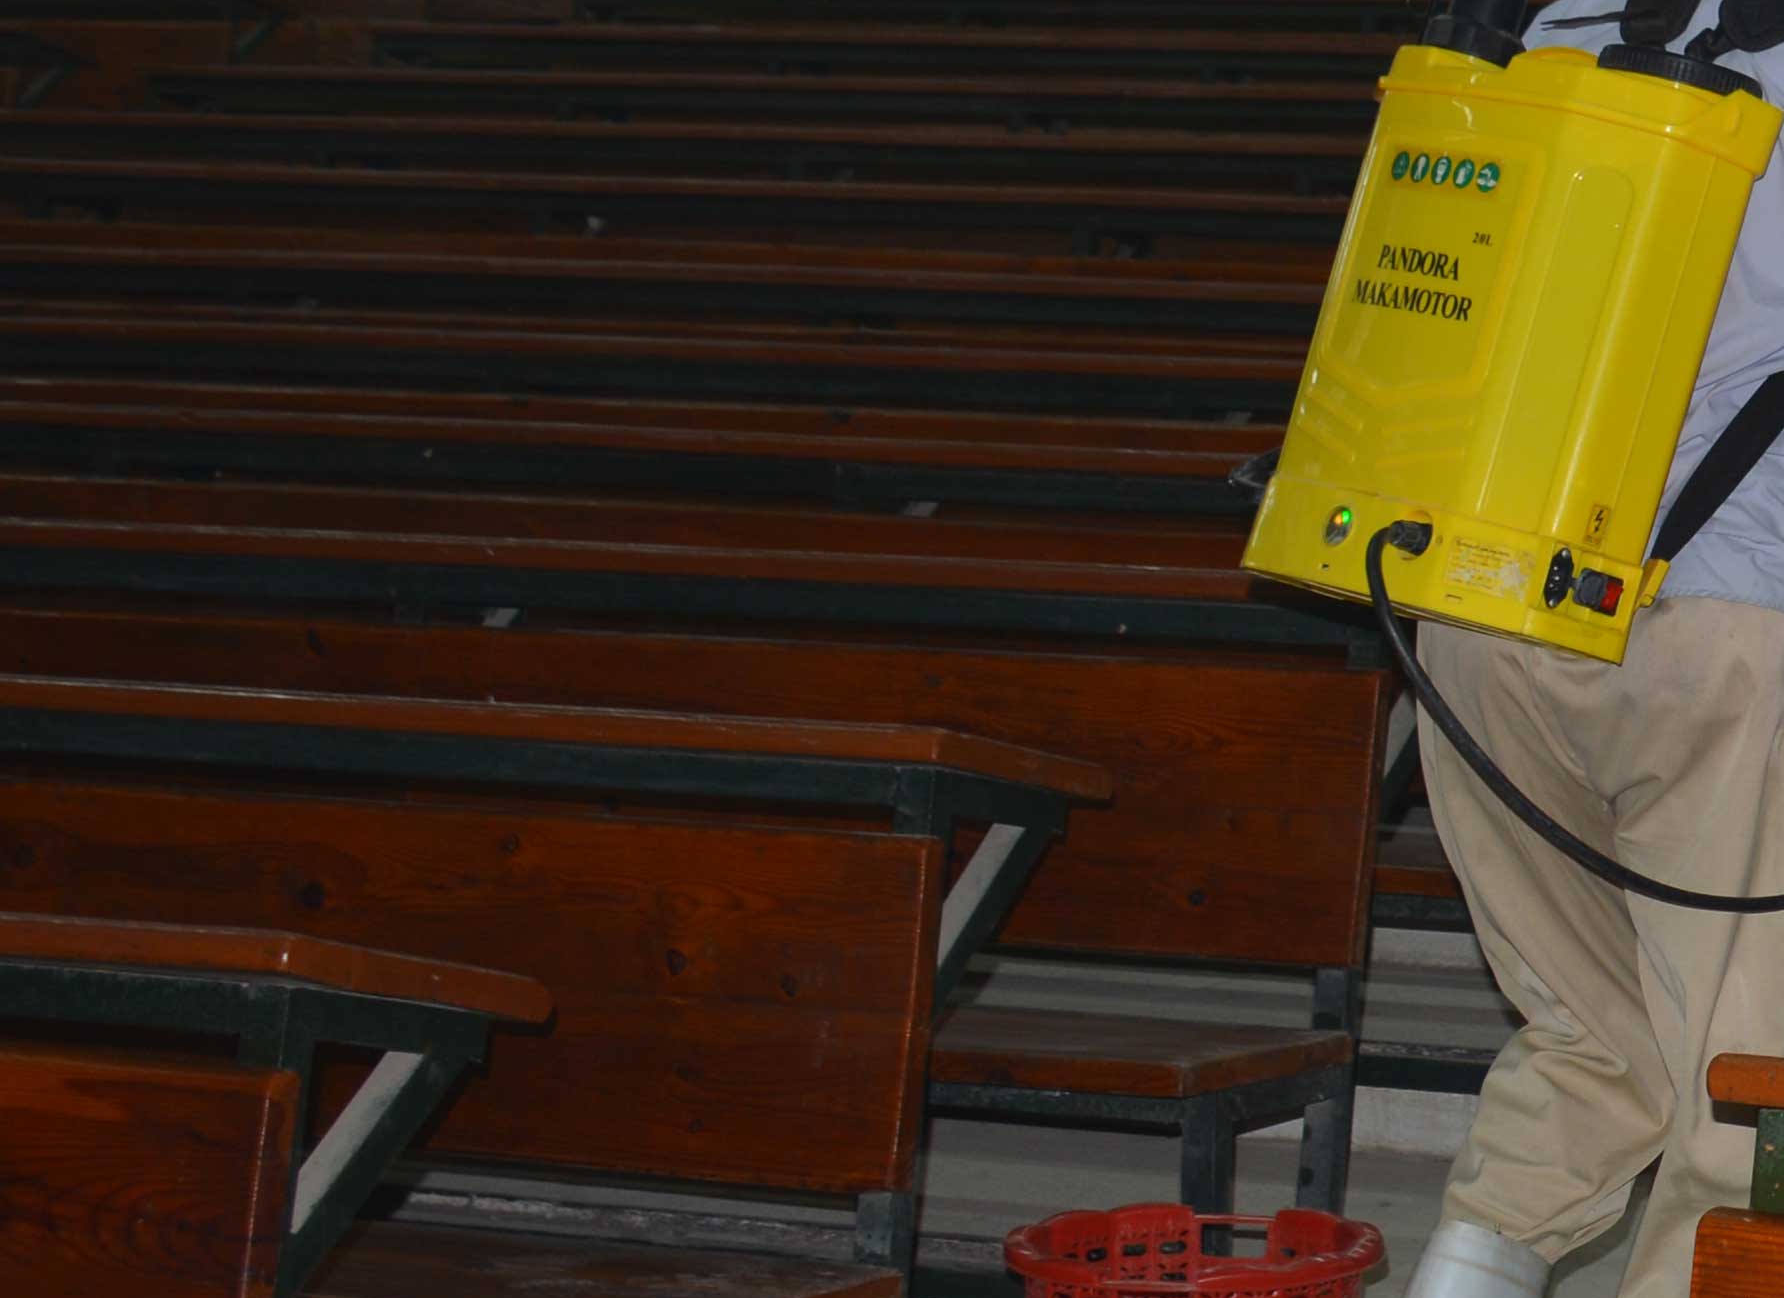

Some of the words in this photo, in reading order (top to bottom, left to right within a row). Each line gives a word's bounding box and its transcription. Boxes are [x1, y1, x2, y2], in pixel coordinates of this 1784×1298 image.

[1472, 232, 1493, 246] 20L
[1377, 244, 1459, 281] PANDORA
[1353, 278, 1472, 322] MAKAMOTOR
